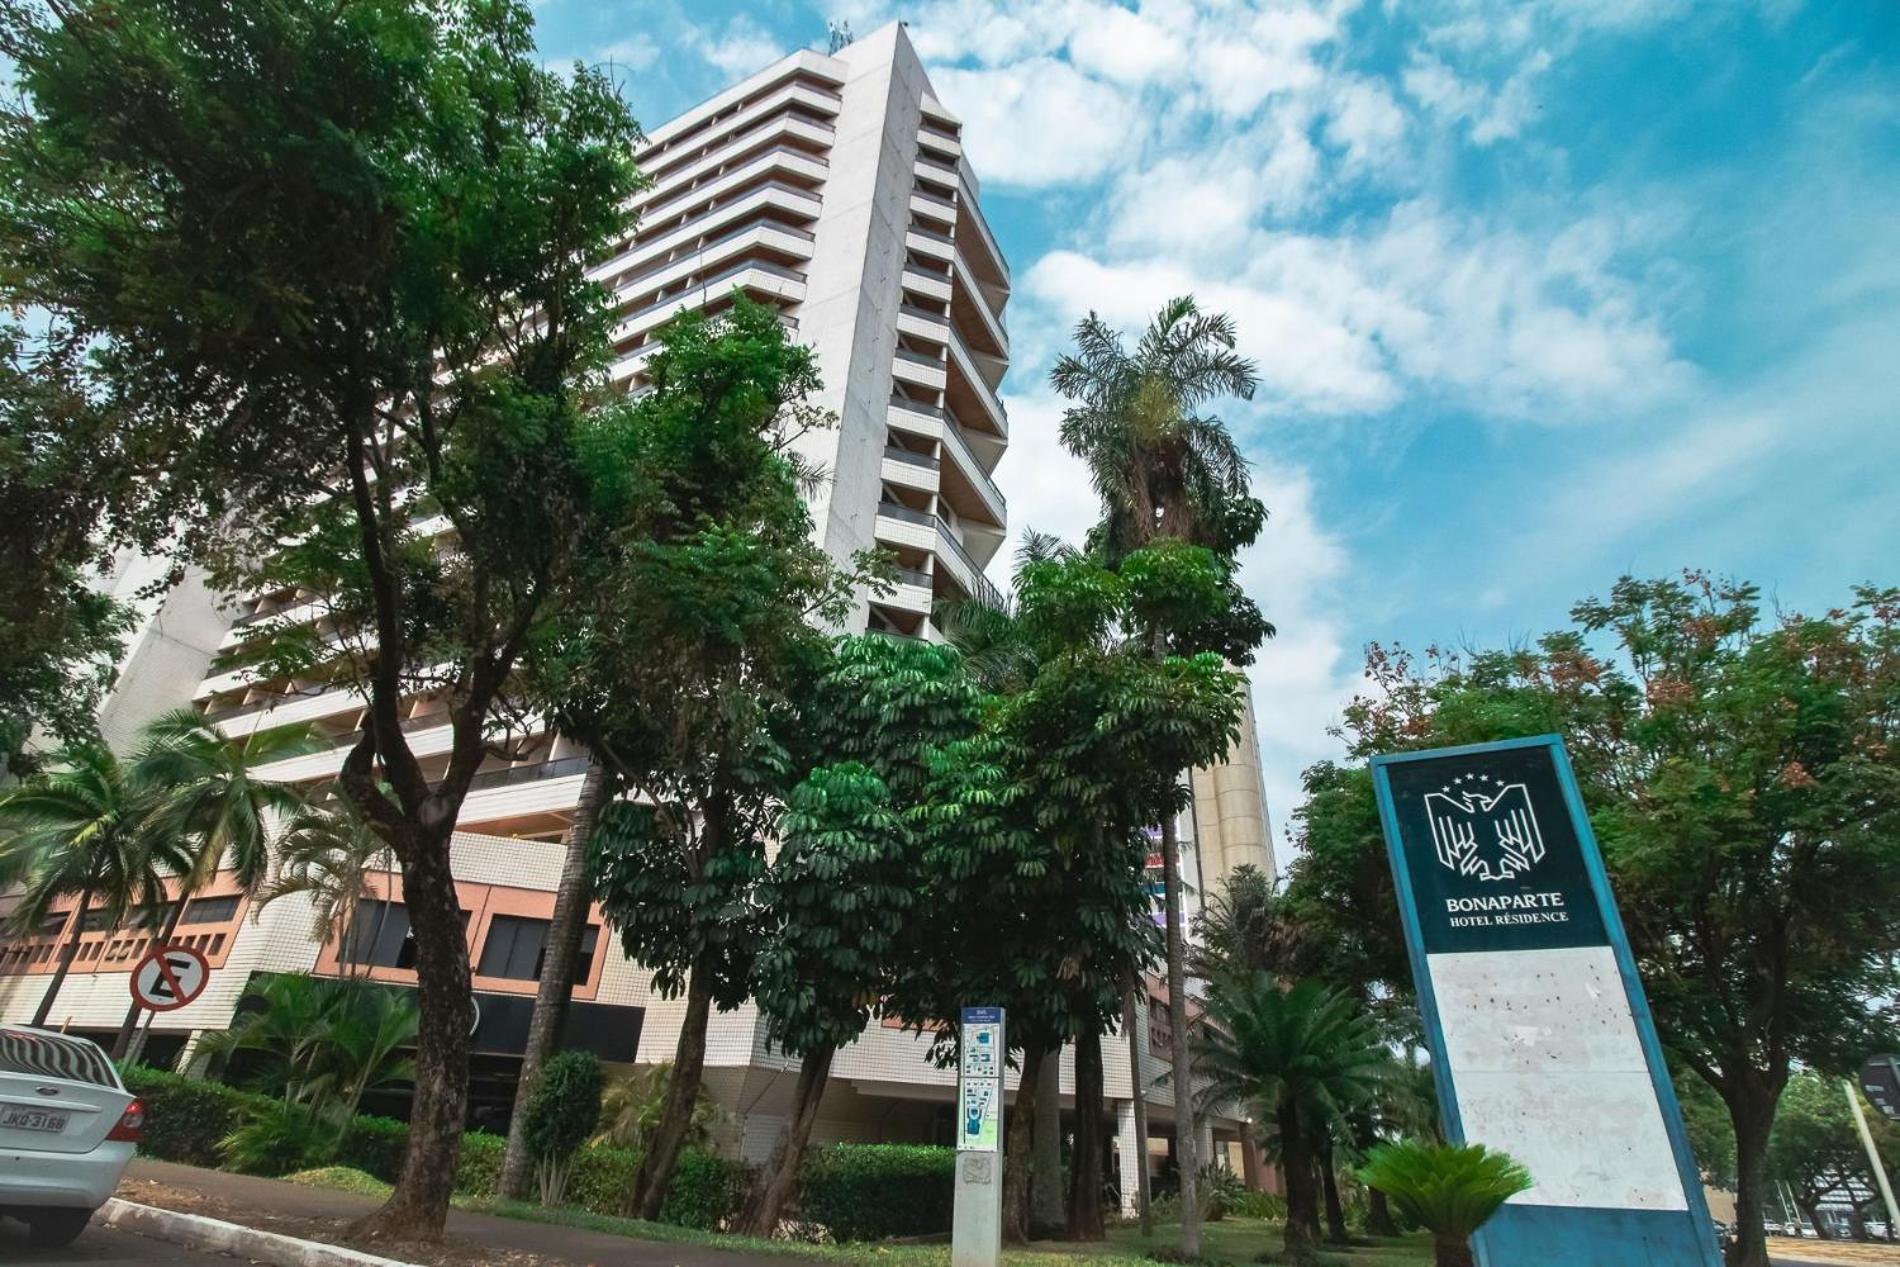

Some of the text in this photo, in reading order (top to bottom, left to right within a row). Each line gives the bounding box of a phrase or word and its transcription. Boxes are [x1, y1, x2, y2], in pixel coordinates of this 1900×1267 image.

[1445, 892, 1565, 912] BONAPARTE
[1450, 911, 1569, 927] HOTEL RÉSIDENCE
[148, 957, 192, 999] E
